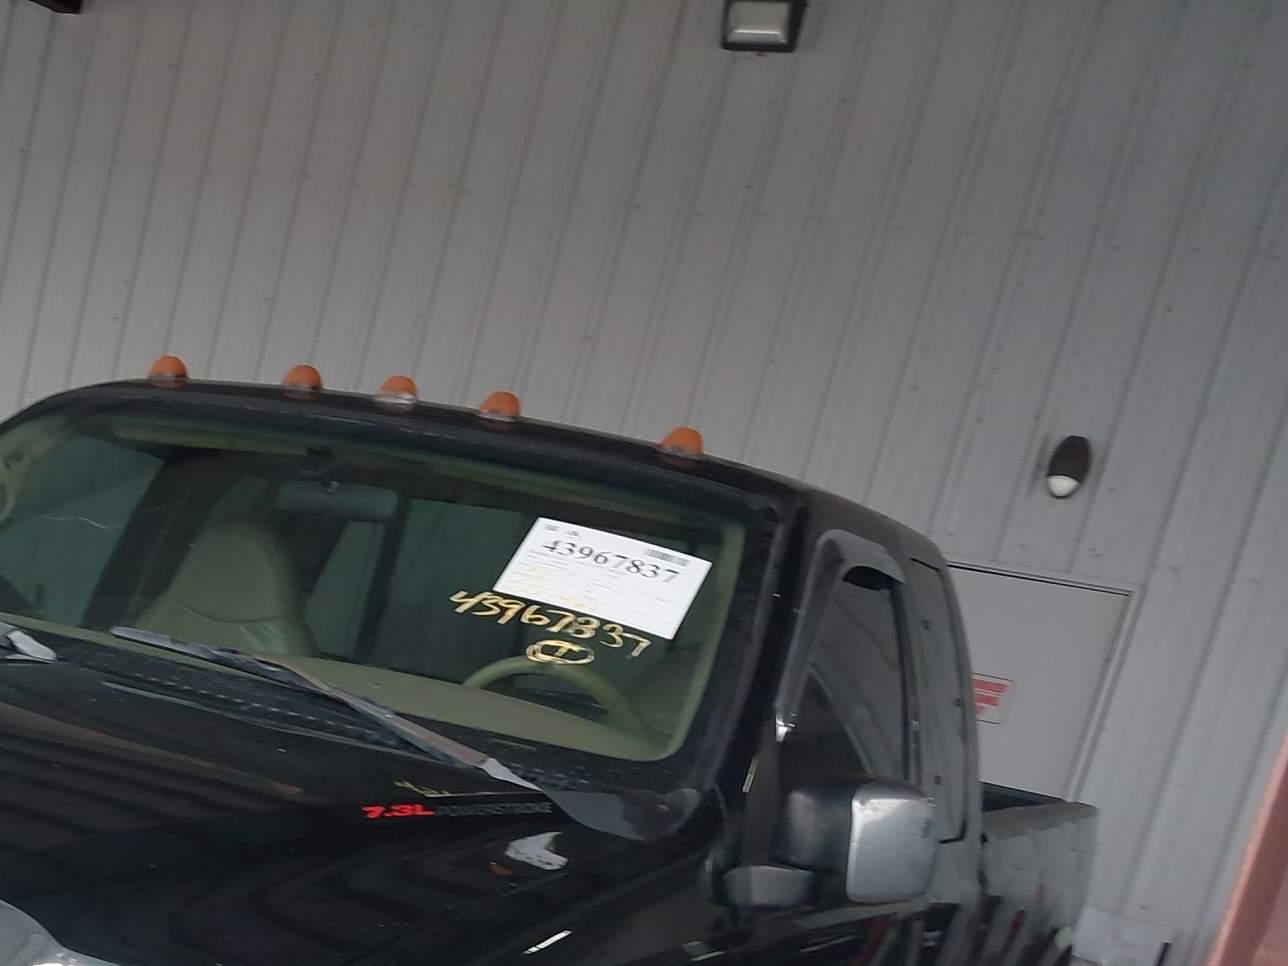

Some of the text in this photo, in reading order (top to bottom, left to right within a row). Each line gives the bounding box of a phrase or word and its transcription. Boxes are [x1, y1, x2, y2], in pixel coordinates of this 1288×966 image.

[542, 539, 681, 583] 43967837
[449, 591, 652, 657] 43967837
[362, 803, 436, 819] 7.3L
